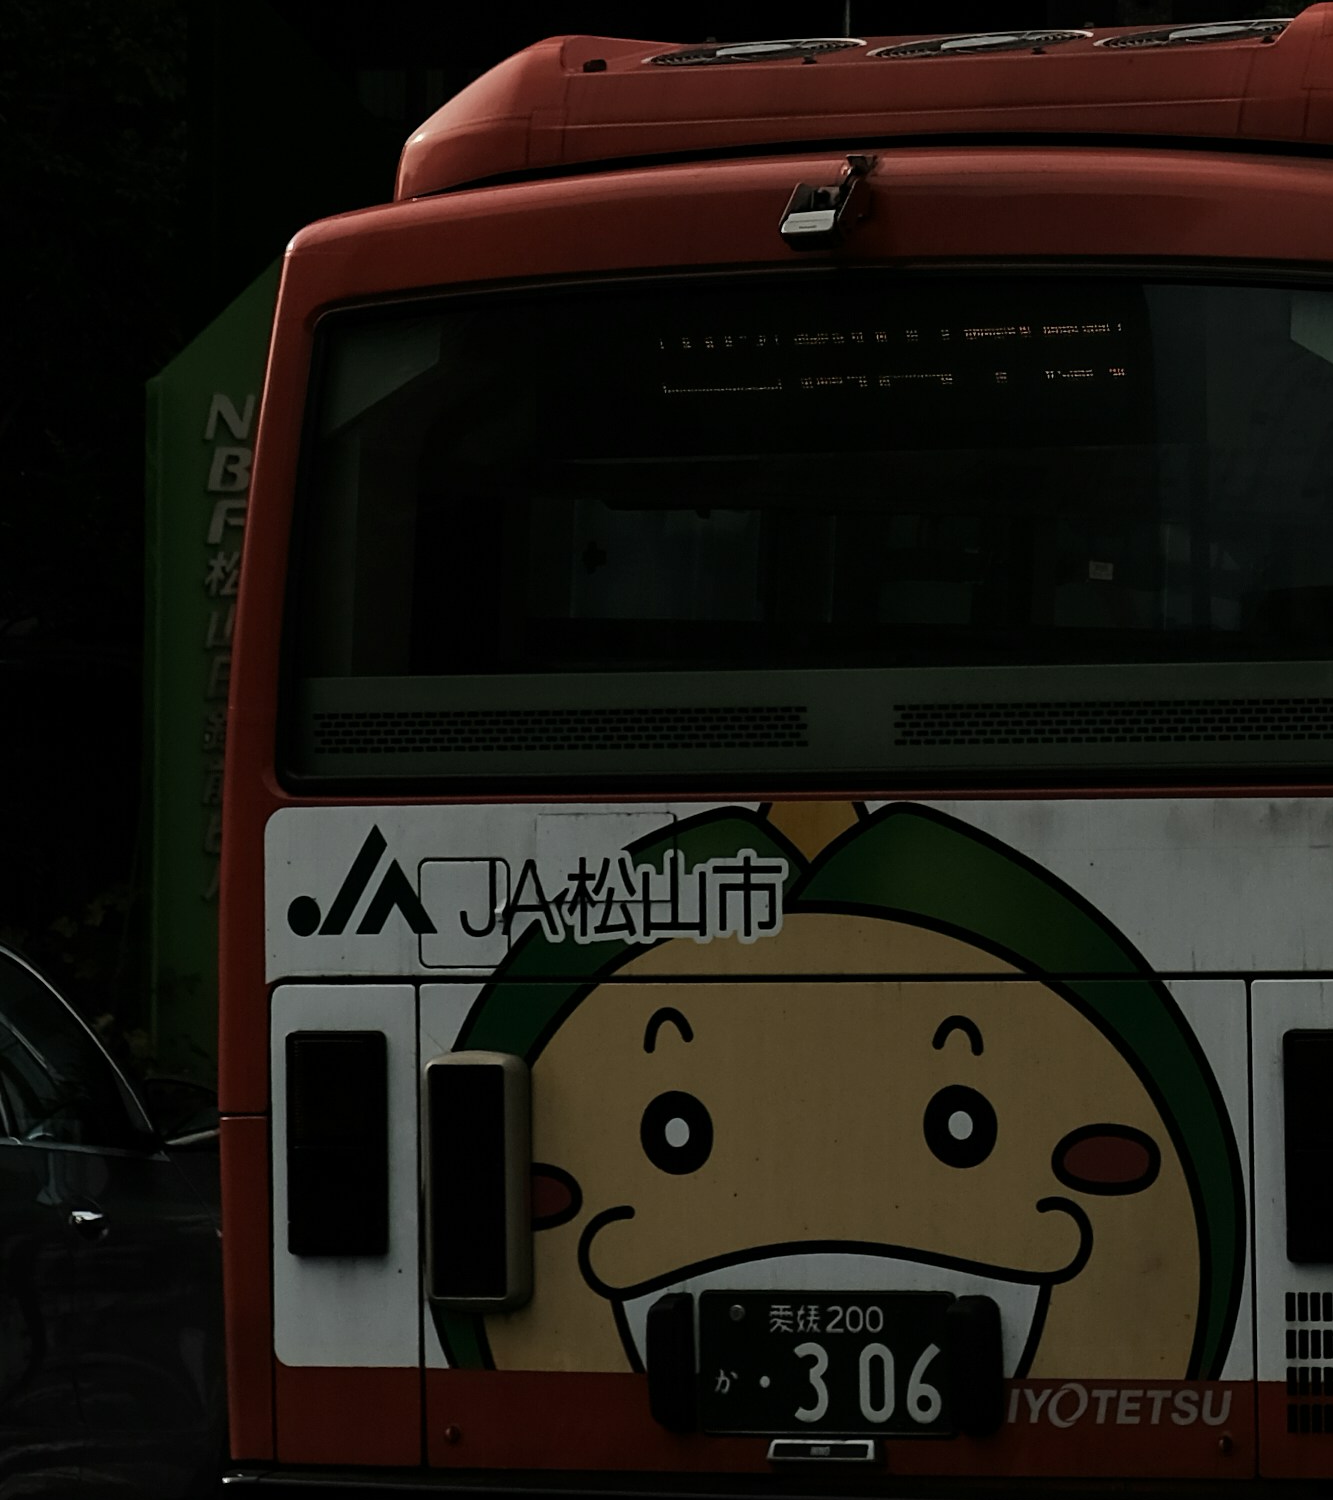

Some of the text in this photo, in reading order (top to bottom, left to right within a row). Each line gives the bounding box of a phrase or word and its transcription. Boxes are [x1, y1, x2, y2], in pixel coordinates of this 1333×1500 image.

[460, 856, 783, 938] JA松山市
[1007, 1382, 1233, 1429] IYOTETSU
